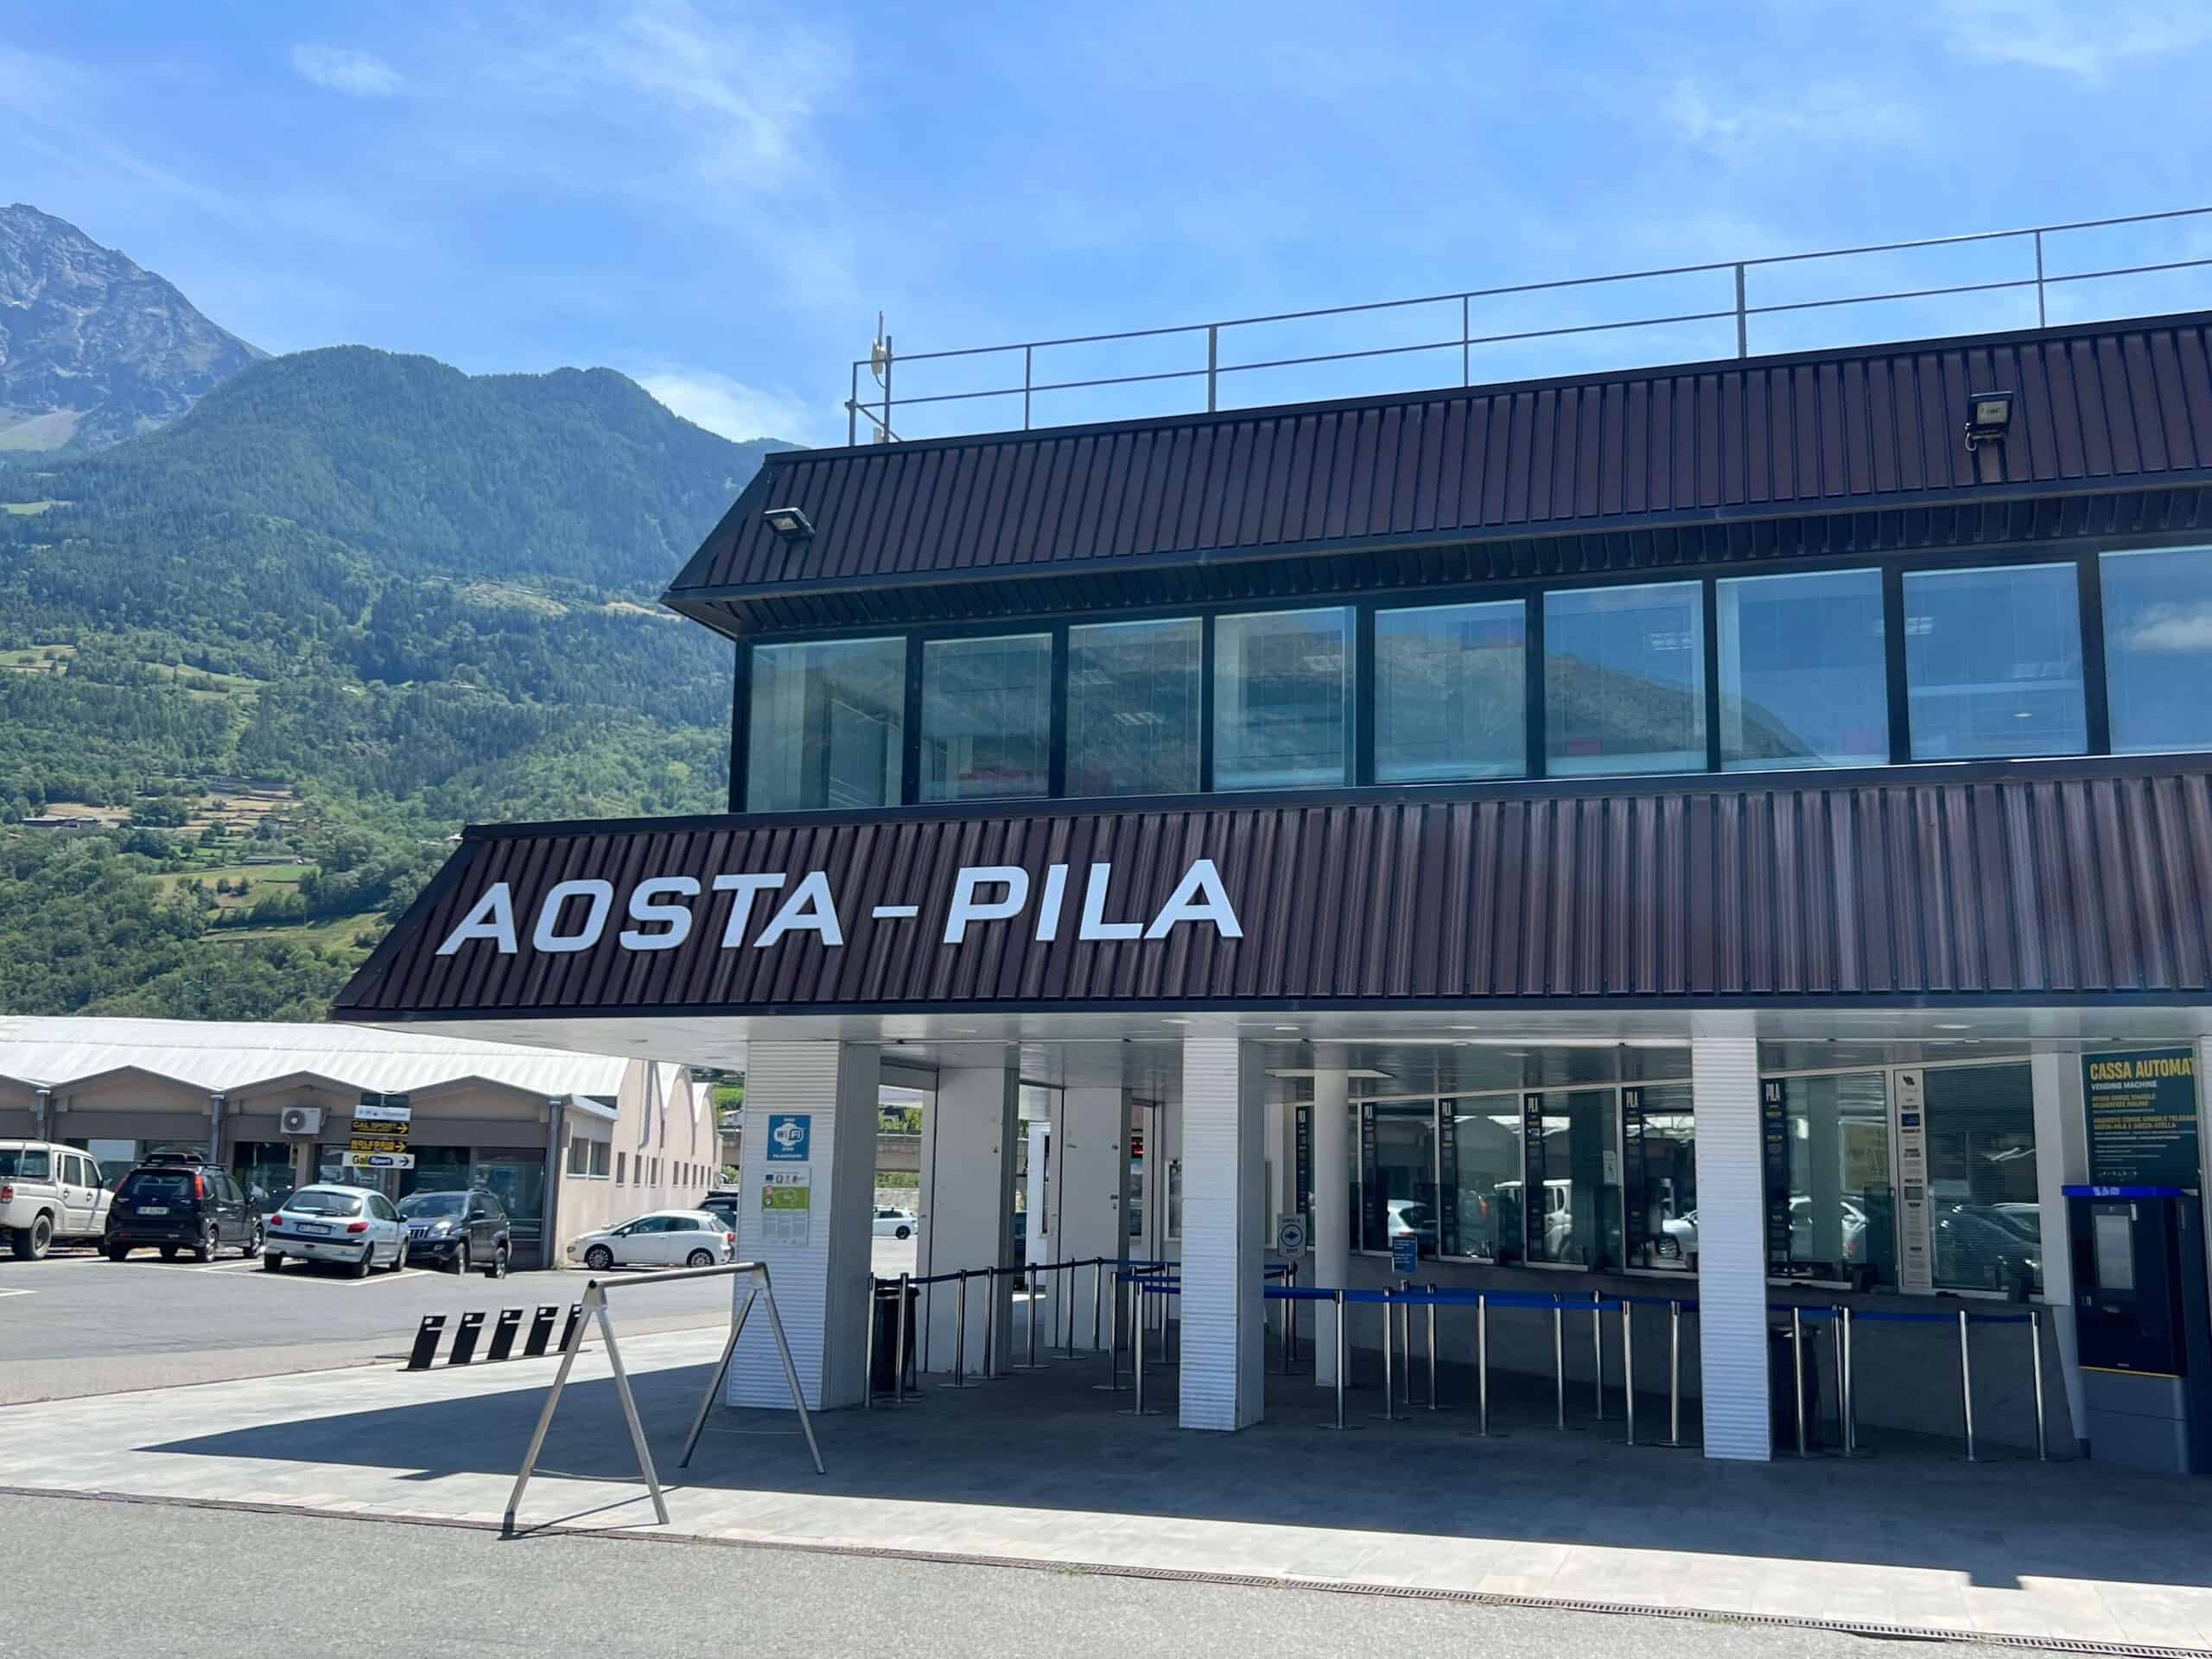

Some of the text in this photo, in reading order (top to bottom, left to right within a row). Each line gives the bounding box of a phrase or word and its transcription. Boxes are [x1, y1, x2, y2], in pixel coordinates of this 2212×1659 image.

[435, 859, 1243, 956] AOSTA - PILA
[2089, 1058, 2194, 1079] CASSA AUTOMA
[1765, 1083, 1781, 1102] PILA
[2123, 1080, 2157, 1089] MACHINE
[1527, 1096, 1538, 1114] PILA
[1626, 1091, 1638, 1108] PILA
